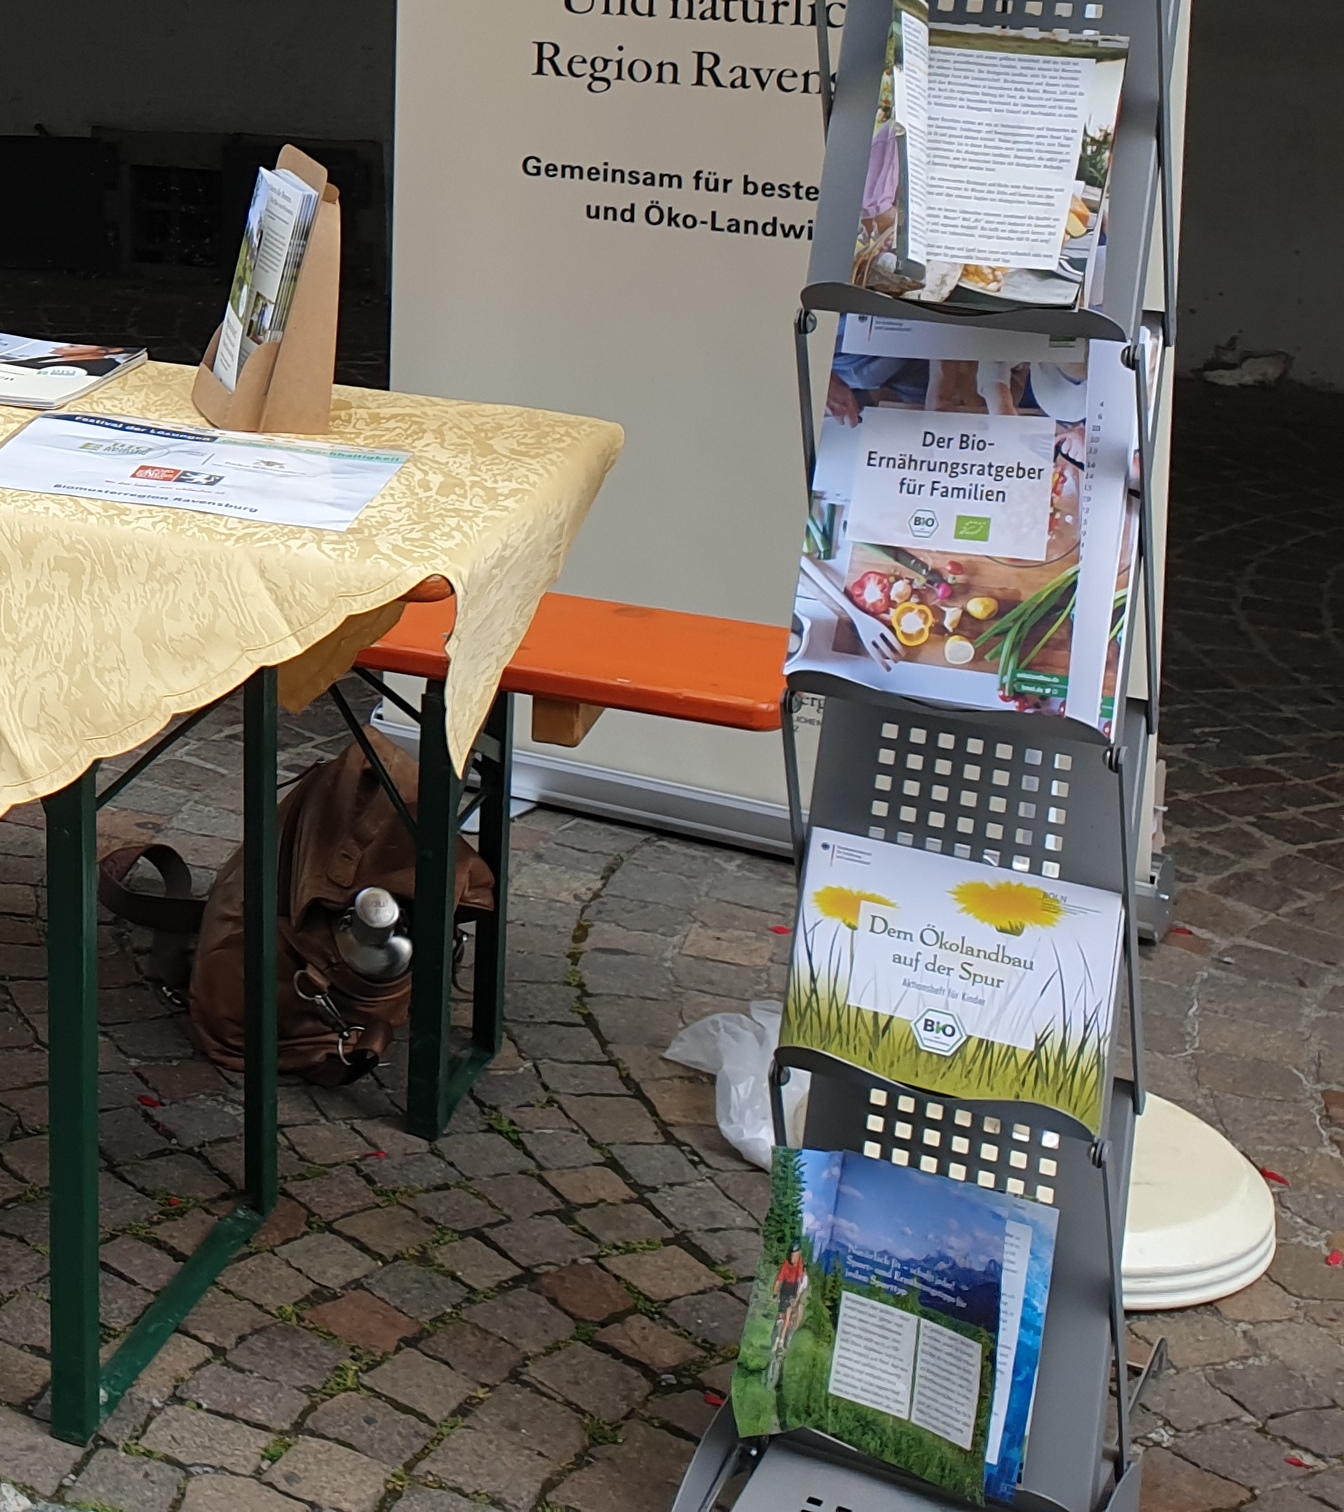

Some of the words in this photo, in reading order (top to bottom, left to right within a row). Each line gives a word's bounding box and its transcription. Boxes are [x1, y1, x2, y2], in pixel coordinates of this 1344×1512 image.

[532, 40, 680, 93] Region
[691, 50, 836, 96] Raven
[521, 155, 683, 190] Gemeinsam
[693, 168, 733, 194] für
[742, 174, 820, 202] beste
[585, 201, 636, 224] und
[645, 202, 814, 241] Öko-Landwi
[74, 415, 123, 429] Festival
[125, 424, 146, 434] der
[922, 431, 954, 450] Der
[959, 433, 996, 452] Bio-
[866, 450, 1045, 482] Ernährungsratgeber
[53, 482, 170, 501] Biomusterregion
[173, 495, 259, 514] Ravensburg
[898, 477, 925, 496] für
[929, 480, 1007, 503] Familien
[868, 914, 914, 944] Dem
[919, 923, 1035, 973] Ökolandbau
[892, 952, 922, 974] auf
[925, 954, 955, 978] der
[958, 962, 1005, 989] Spur
[962, 992, 986, 1006] Kinder
